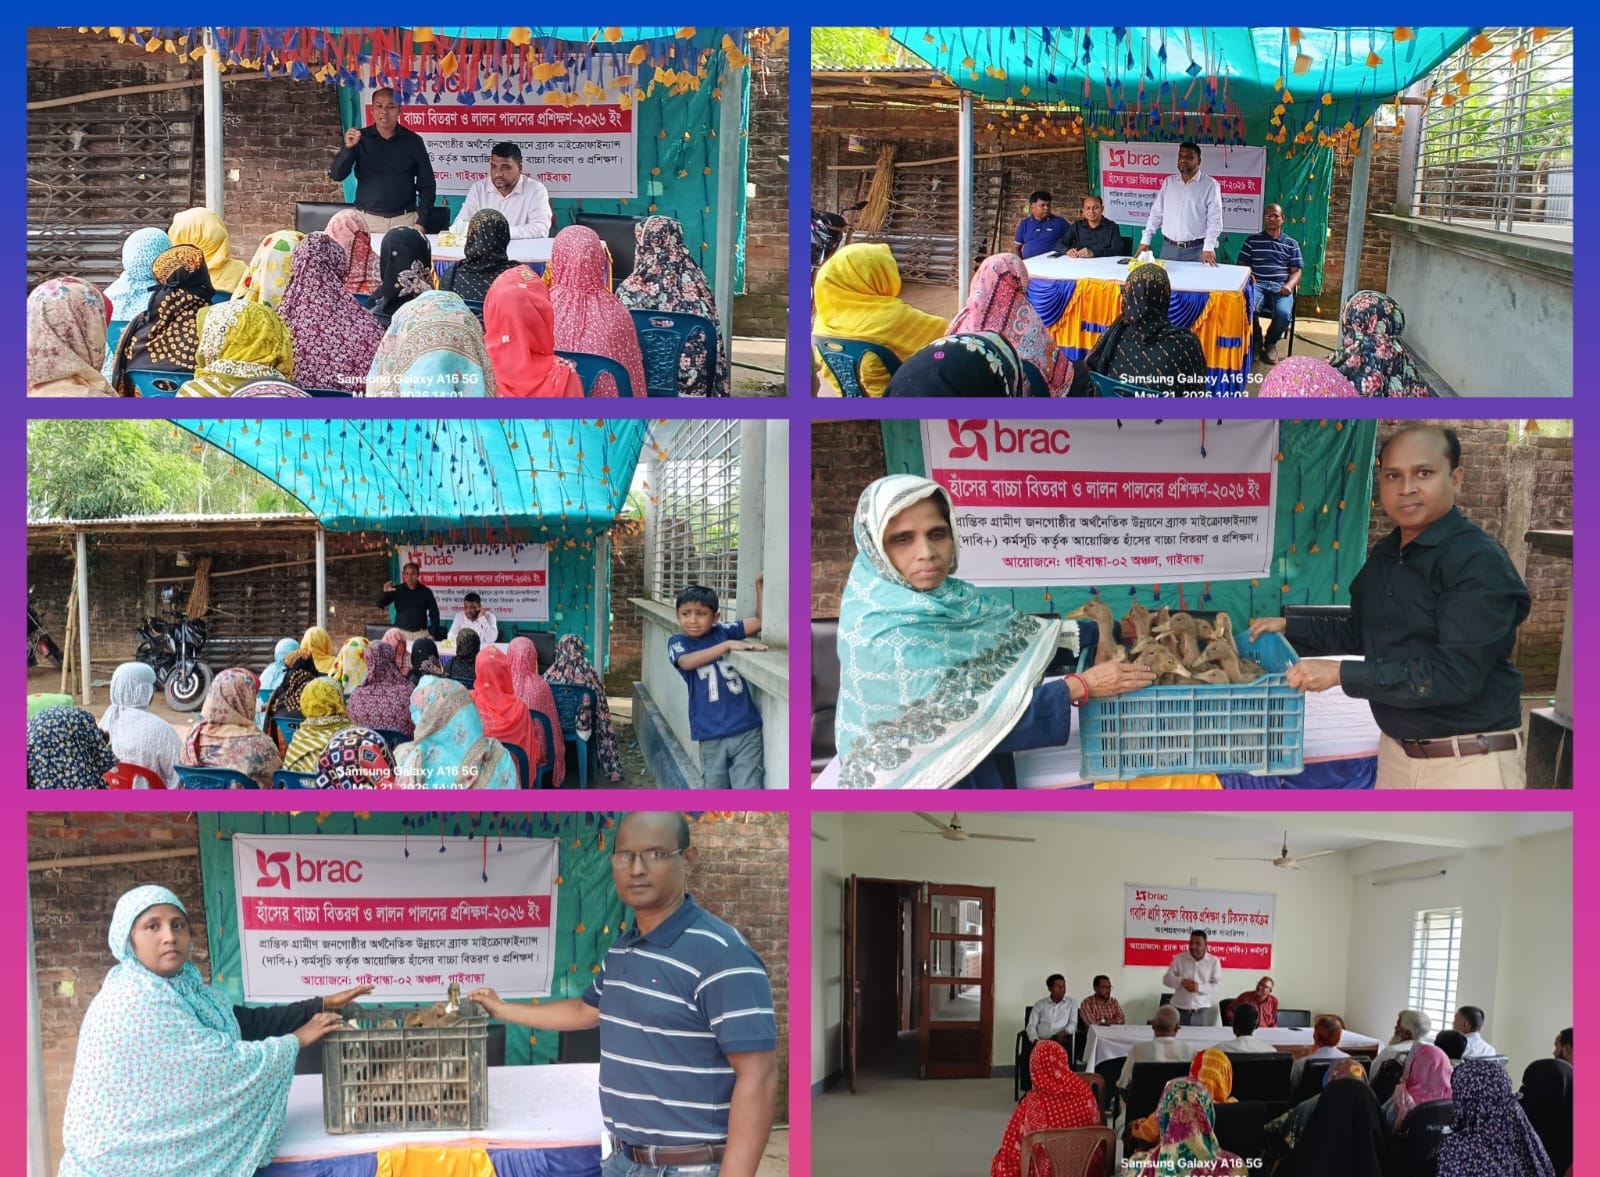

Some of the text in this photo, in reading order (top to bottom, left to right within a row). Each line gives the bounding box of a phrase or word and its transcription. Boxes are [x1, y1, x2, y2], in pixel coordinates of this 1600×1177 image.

[427, 108, 458, 126] বিতরণ
[461, 113, 469, 125] ও
[471, 112, 497, 127] লালন
[499, 112, 535, 127] পালনের
[608, 108, 623, 127] ইং
[1127, 150, 1161, 166] brac
[995, 419, 1071, 455] brac
[948, 473, 1261, 501] হাঁসের বাচ্চা বিতরণ ও লালন পালনের প্রশিক্ষণ-২০২৬ ইং
[990, 513, 1021, 529] গ্রামীণ
[1025, 514, 1076, 529] জনগোষ্ঠীর
[1080, 514, 1128, 530] অর্থনৈতিক
[1131, 515, 1163, 530] উন্নয়নে
[1002, 533, 1037, 550] কর্মসূচি
[1041, 534, 1069, 550] কর্তৃক
[1071, 534, 1120, 547] আয়োজিত
[1123, 532, 1151, 547] হাঁসের
[1154, 534, 1176, 546] বাচ্চা
[1179, 532, 1208, 545] বিতরণ
[1212, 535, 1219, 544] ও
[424, 552, 453, 567] brac
[1166, 552, 1204, 566] গাইবান্ধা
[696, 660, 744, 703] 75
[296, 852, 363, 883] brac
[1147, 892, 1168, 901] brac
[256, 899, 541, 924] হাঁসের বাচ্চা বিতরণ ও লালন পালনের প্রশিক্ষণ-২০২৬ ইং
